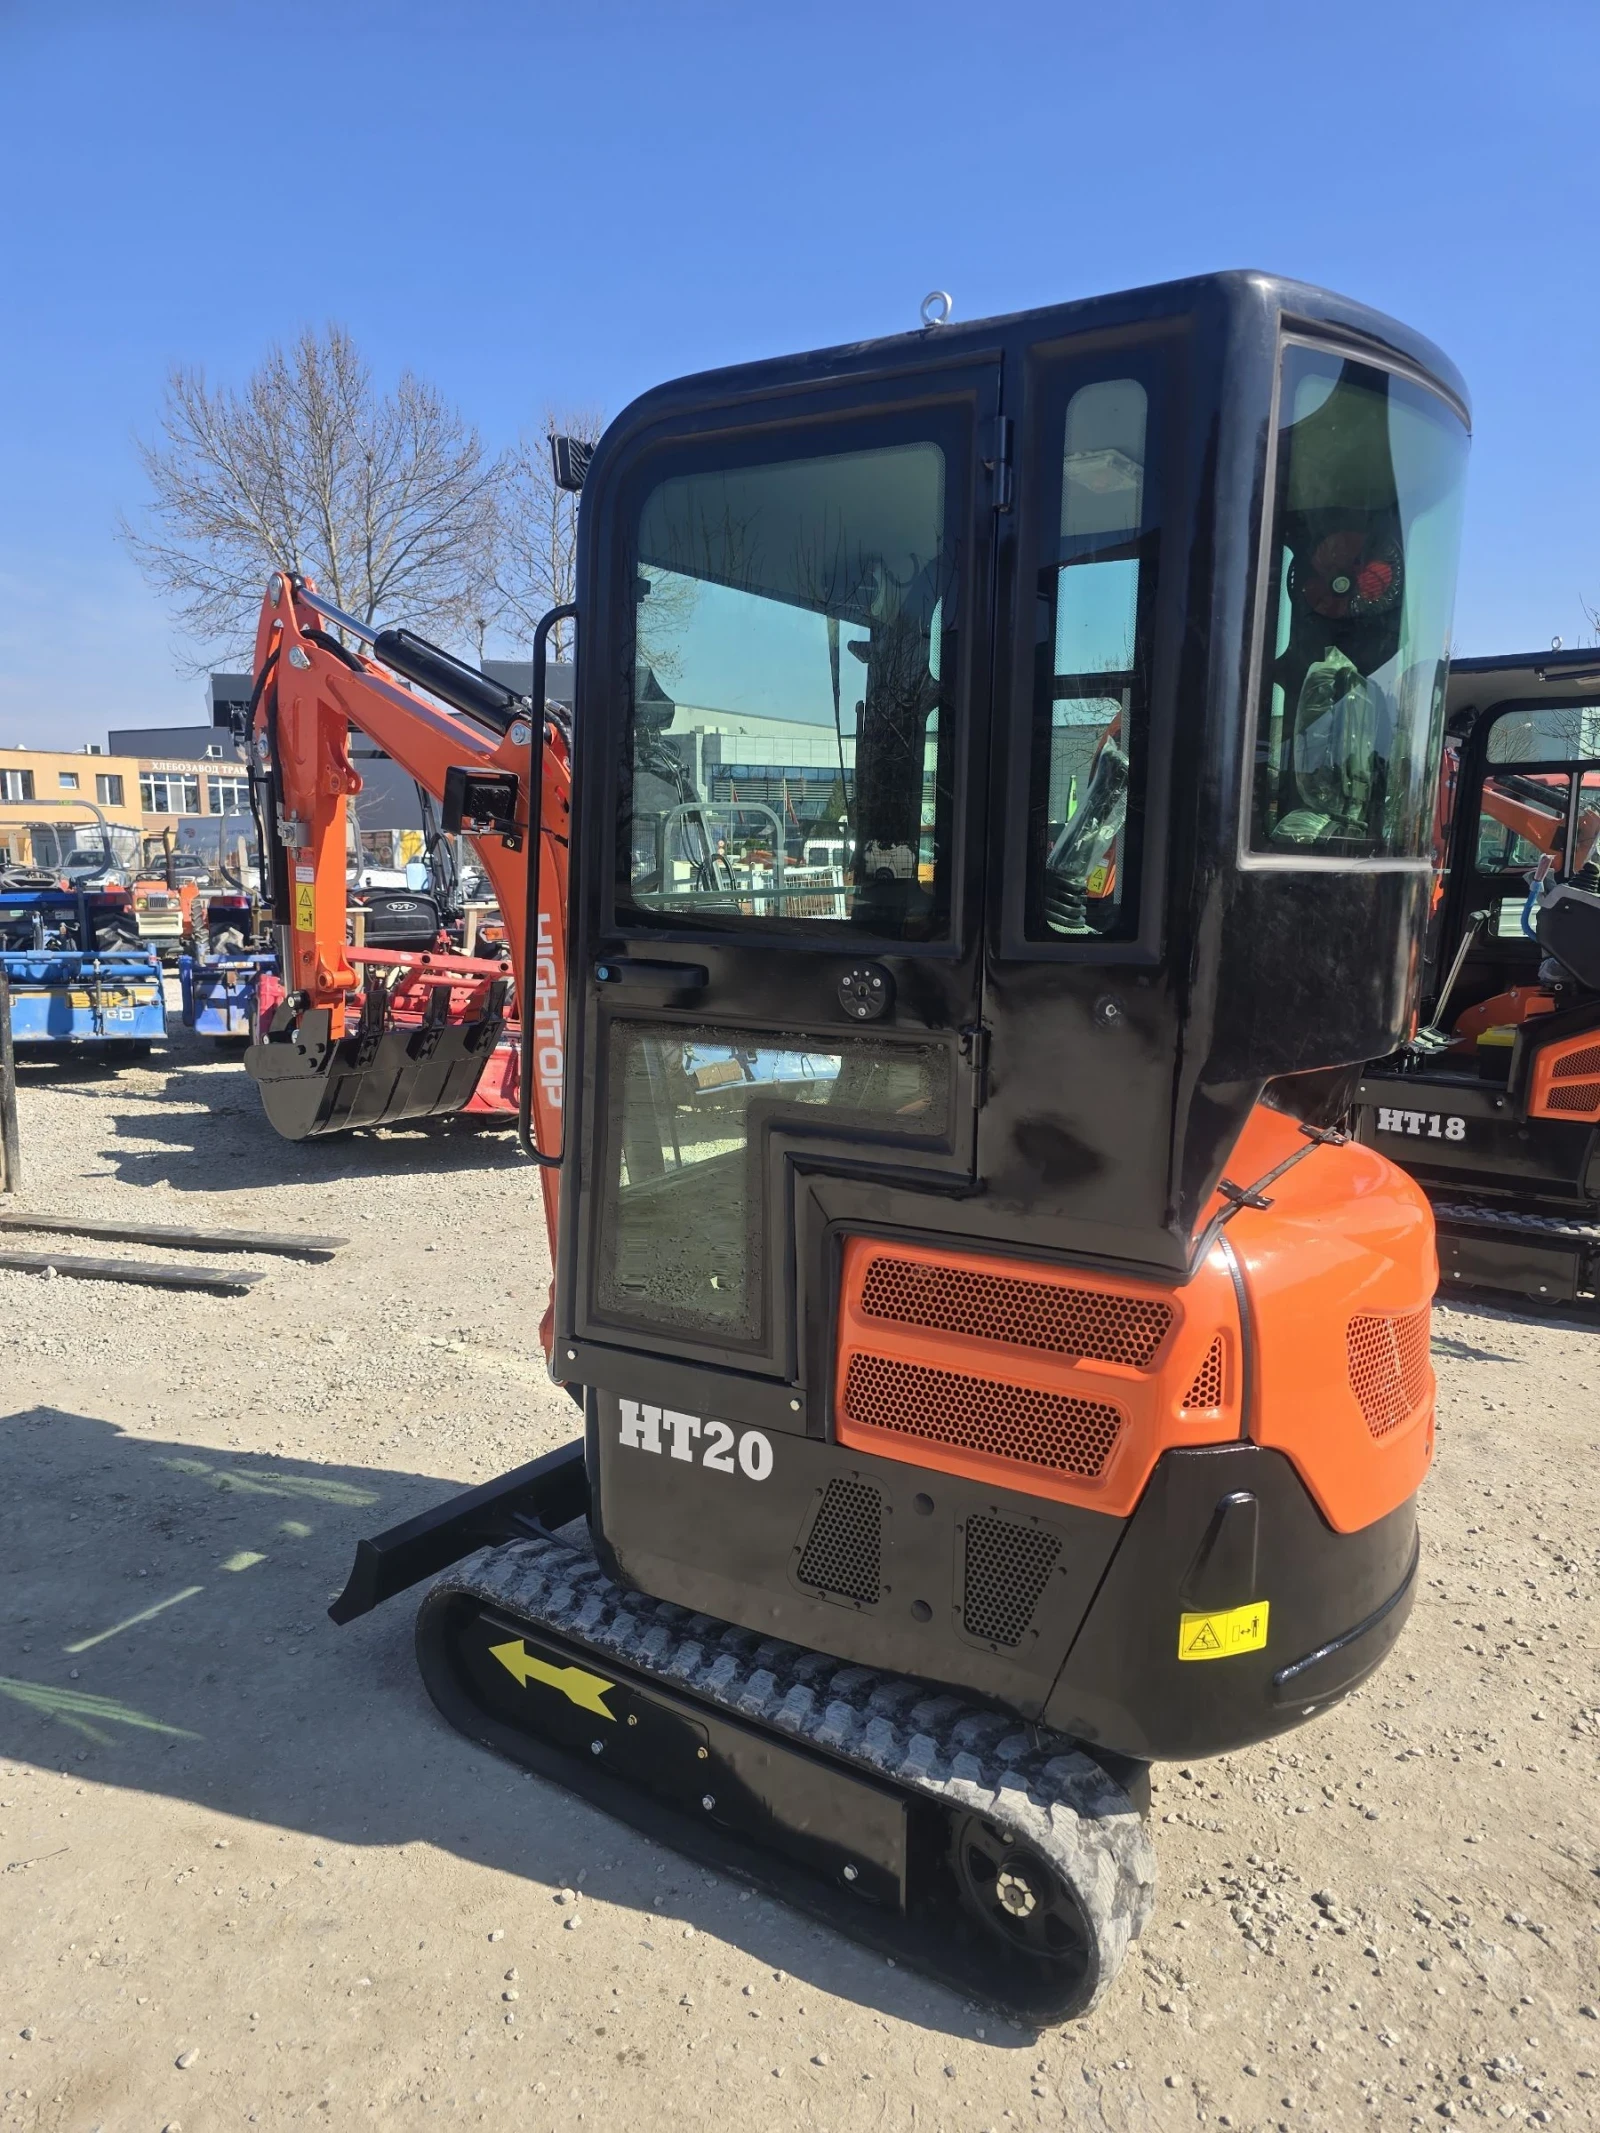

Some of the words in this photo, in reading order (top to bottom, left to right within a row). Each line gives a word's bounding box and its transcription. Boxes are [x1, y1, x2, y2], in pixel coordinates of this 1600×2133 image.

[152, 762, 219, 775] ХЛЕБОЗАВОД
[1377, 1107, 1465, 1140] HT18
[619, 1398, 773, 1481] HT20
